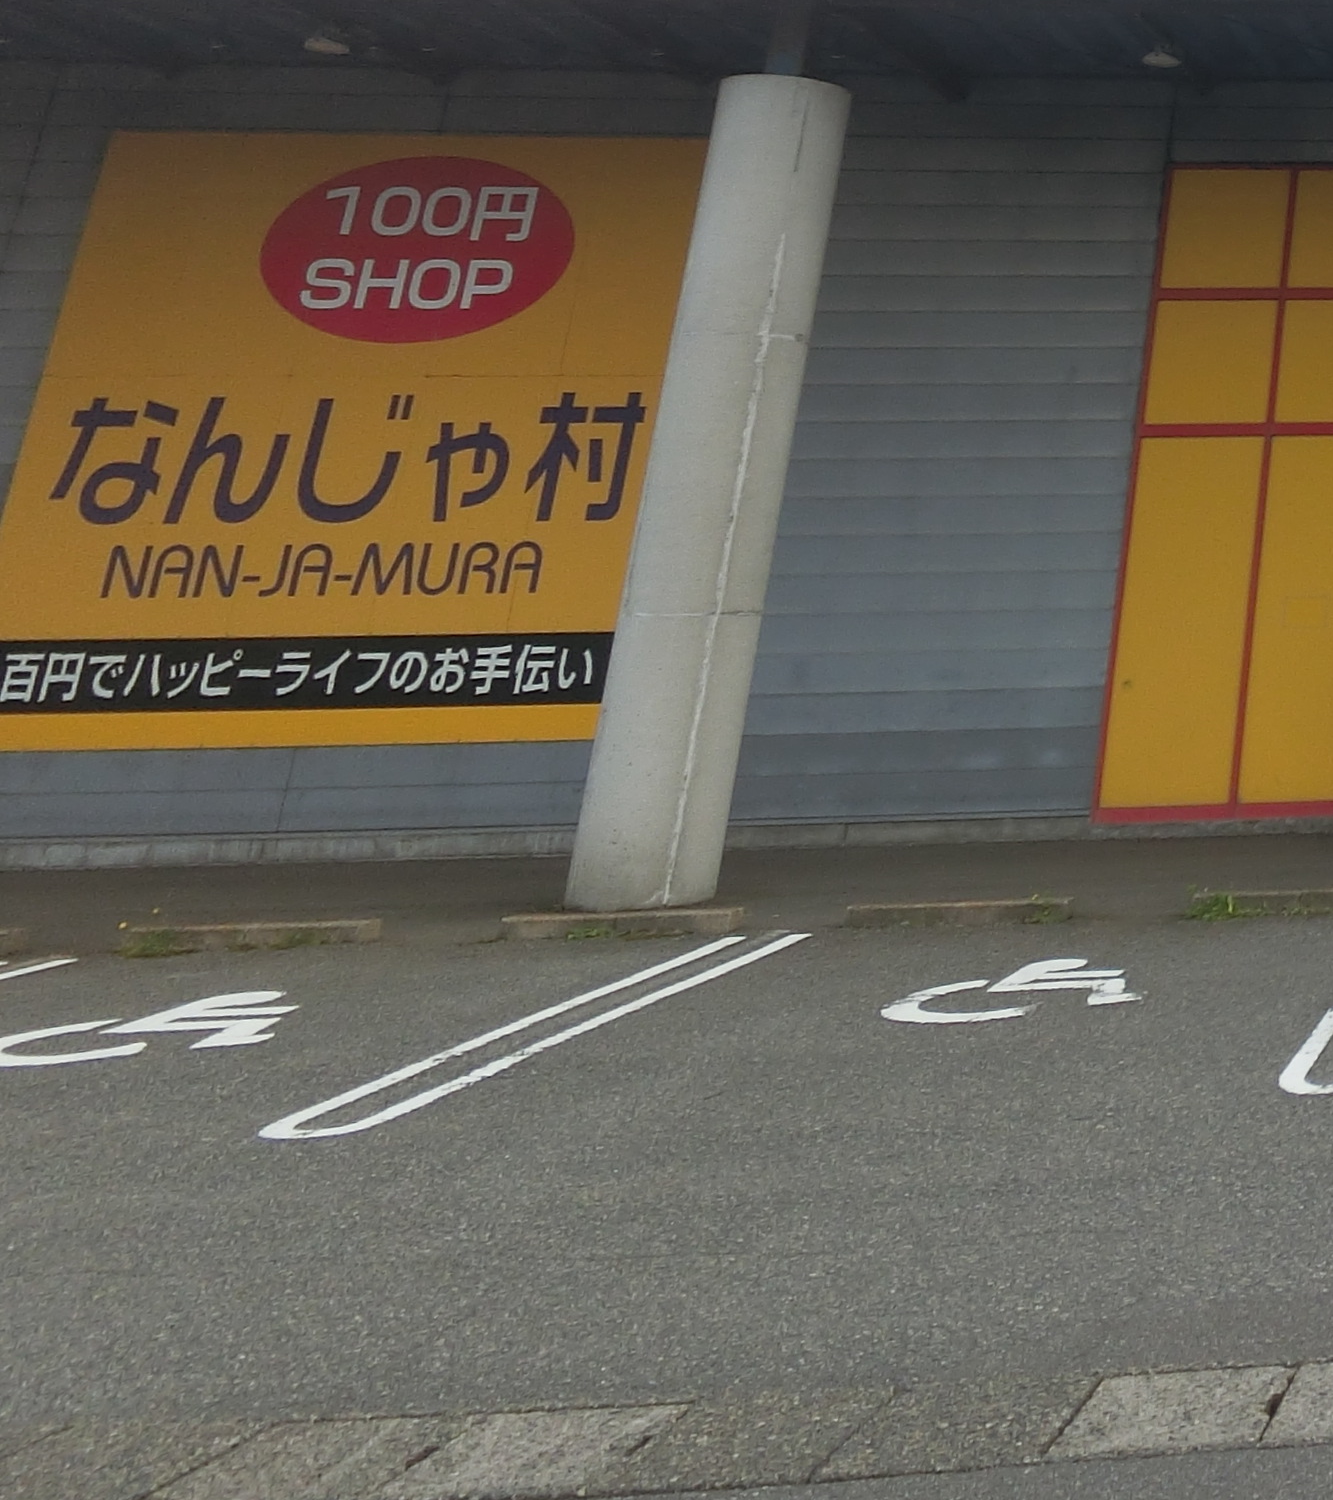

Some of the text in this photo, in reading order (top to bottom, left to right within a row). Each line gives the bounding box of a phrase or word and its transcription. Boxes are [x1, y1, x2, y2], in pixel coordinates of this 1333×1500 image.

[324, 185, 540, 243] 100円
[299, 258, 514, 311] SHOP
[48, 391, 647, 525] なんじゃ村
[99, 541, 544, 598] NAN-JA-MURA
[0, 643, 595, 703] 百円でハッピーライフのお手伝い
